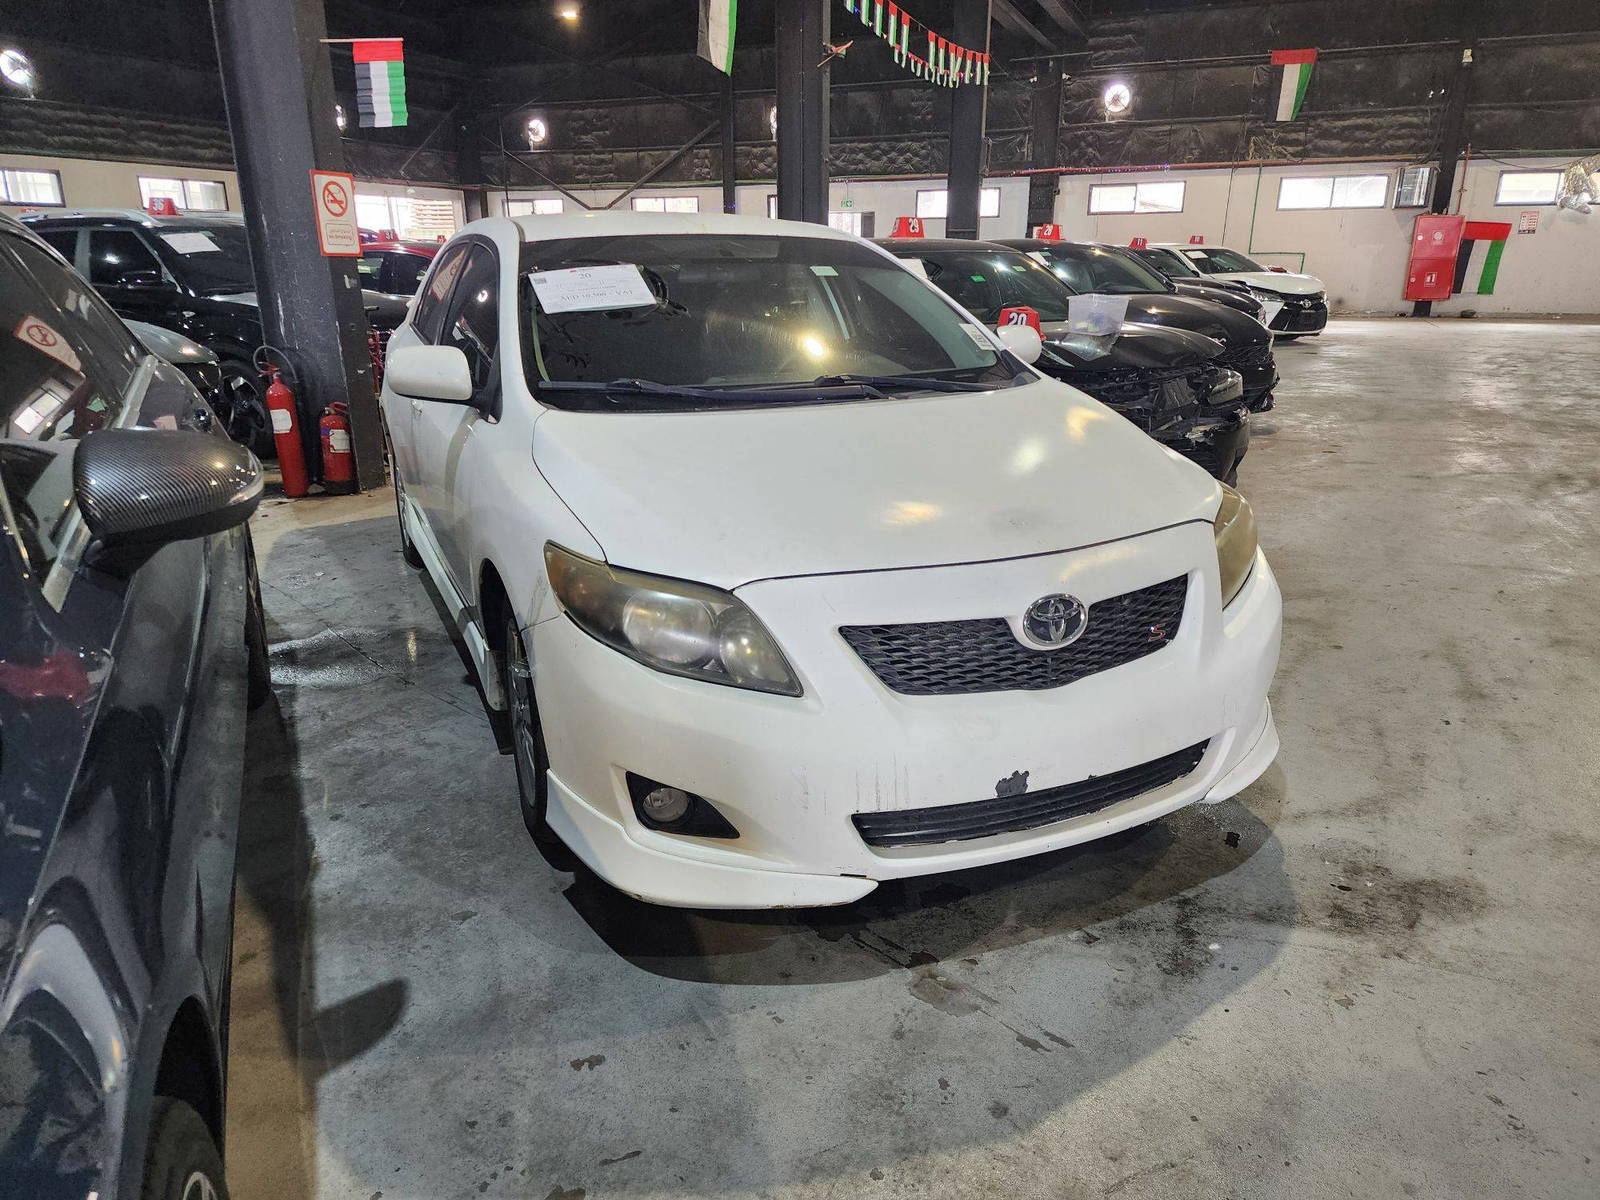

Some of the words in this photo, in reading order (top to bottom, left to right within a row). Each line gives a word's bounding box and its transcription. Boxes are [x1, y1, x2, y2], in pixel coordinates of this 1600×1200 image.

[908, 217, 919, 233] 29
[1007, 311, 1028, 326] 20
[1148, 623, 1166, 641] S
